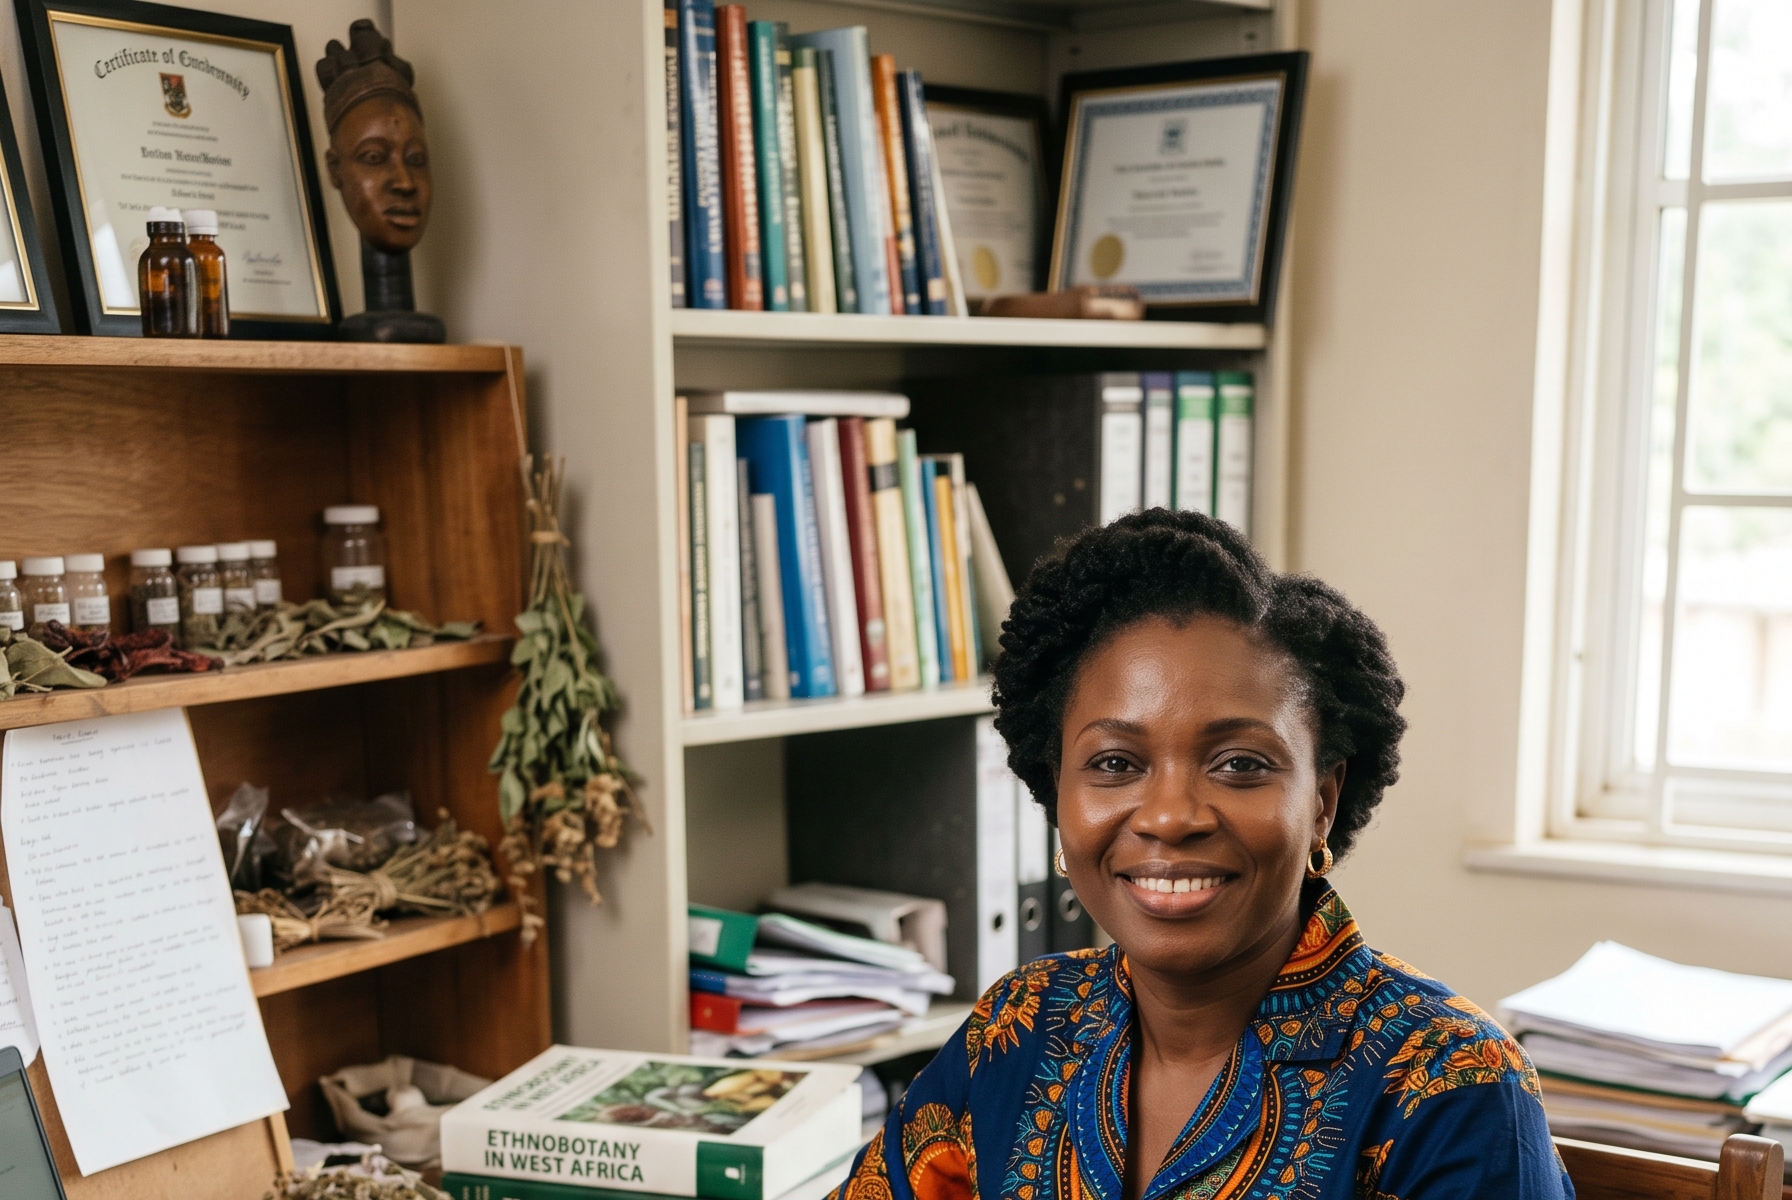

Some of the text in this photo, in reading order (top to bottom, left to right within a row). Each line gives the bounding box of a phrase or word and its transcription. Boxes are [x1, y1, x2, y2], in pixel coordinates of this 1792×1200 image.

[94, 48, 159, 79] Certificate
[162, 48, 176, 65] of
[487, 1129, 641, 1161] ETHNOBOTANY
[484, 1150, 644, 1183] IN WEST AFRICA
